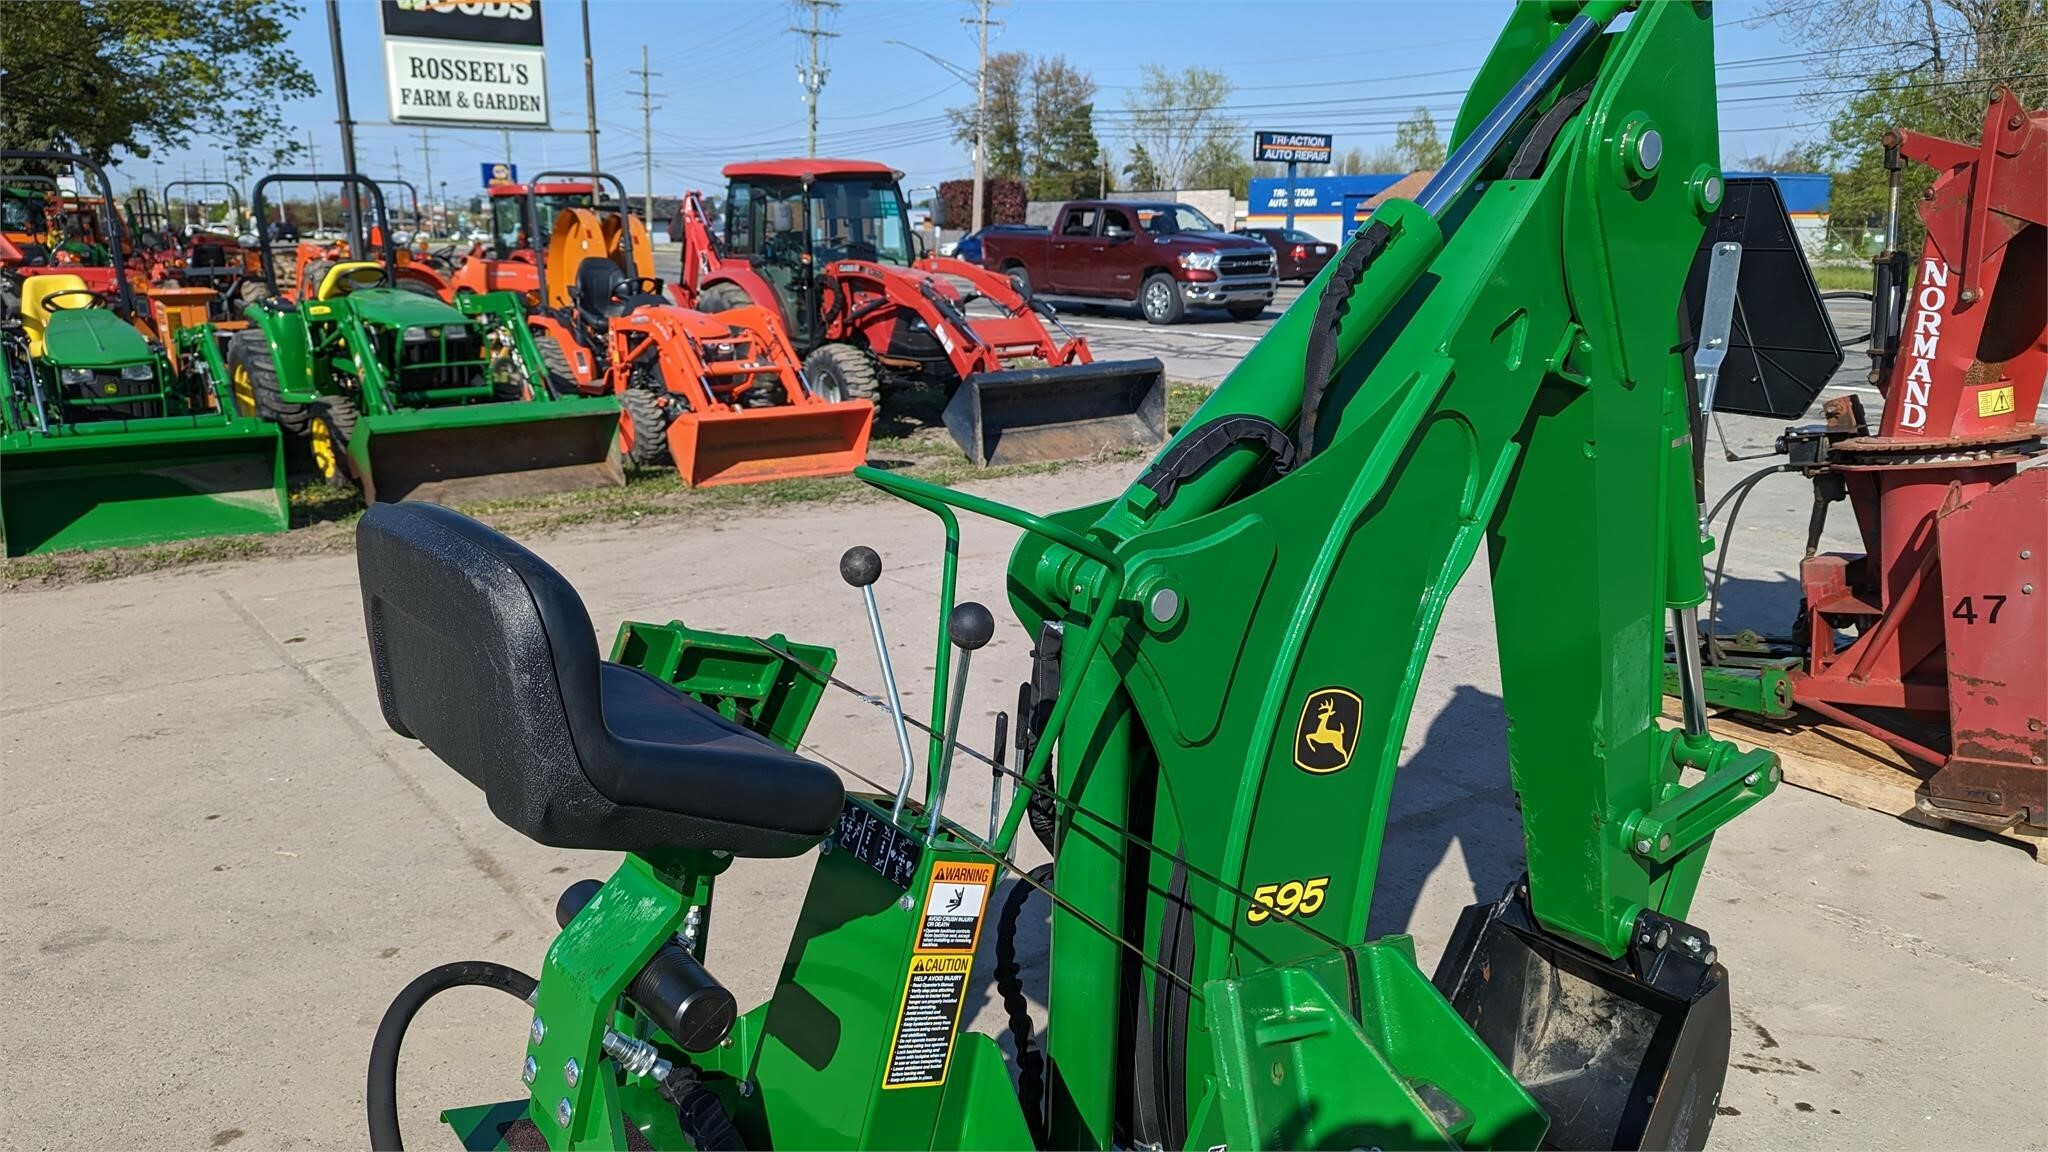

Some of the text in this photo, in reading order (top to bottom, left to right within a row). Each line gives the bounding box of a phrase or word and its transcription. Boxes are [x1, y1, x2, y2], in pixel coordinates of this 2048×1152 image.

[409, 56, 528, 85] ROSSEEL'S
[401, 88, 541, 112] FARM & GARDEN
[1271, 134, 1326, 147] TRI-ACTION
[1264, 149, 1328, 161] AUTO REPAIR
[1273, 188, 1316, 197] TRI-TION
[1294, 198, 1318, 207] EPAIR
[1901, 260, 1949, 428] NORMAND
[1952, 595, 2007, 625] 47
[945, 867, 989, 882] WARNING
[1247, 876, 1331, 925] 595
[925, 958, 969, 972] CAUTION
